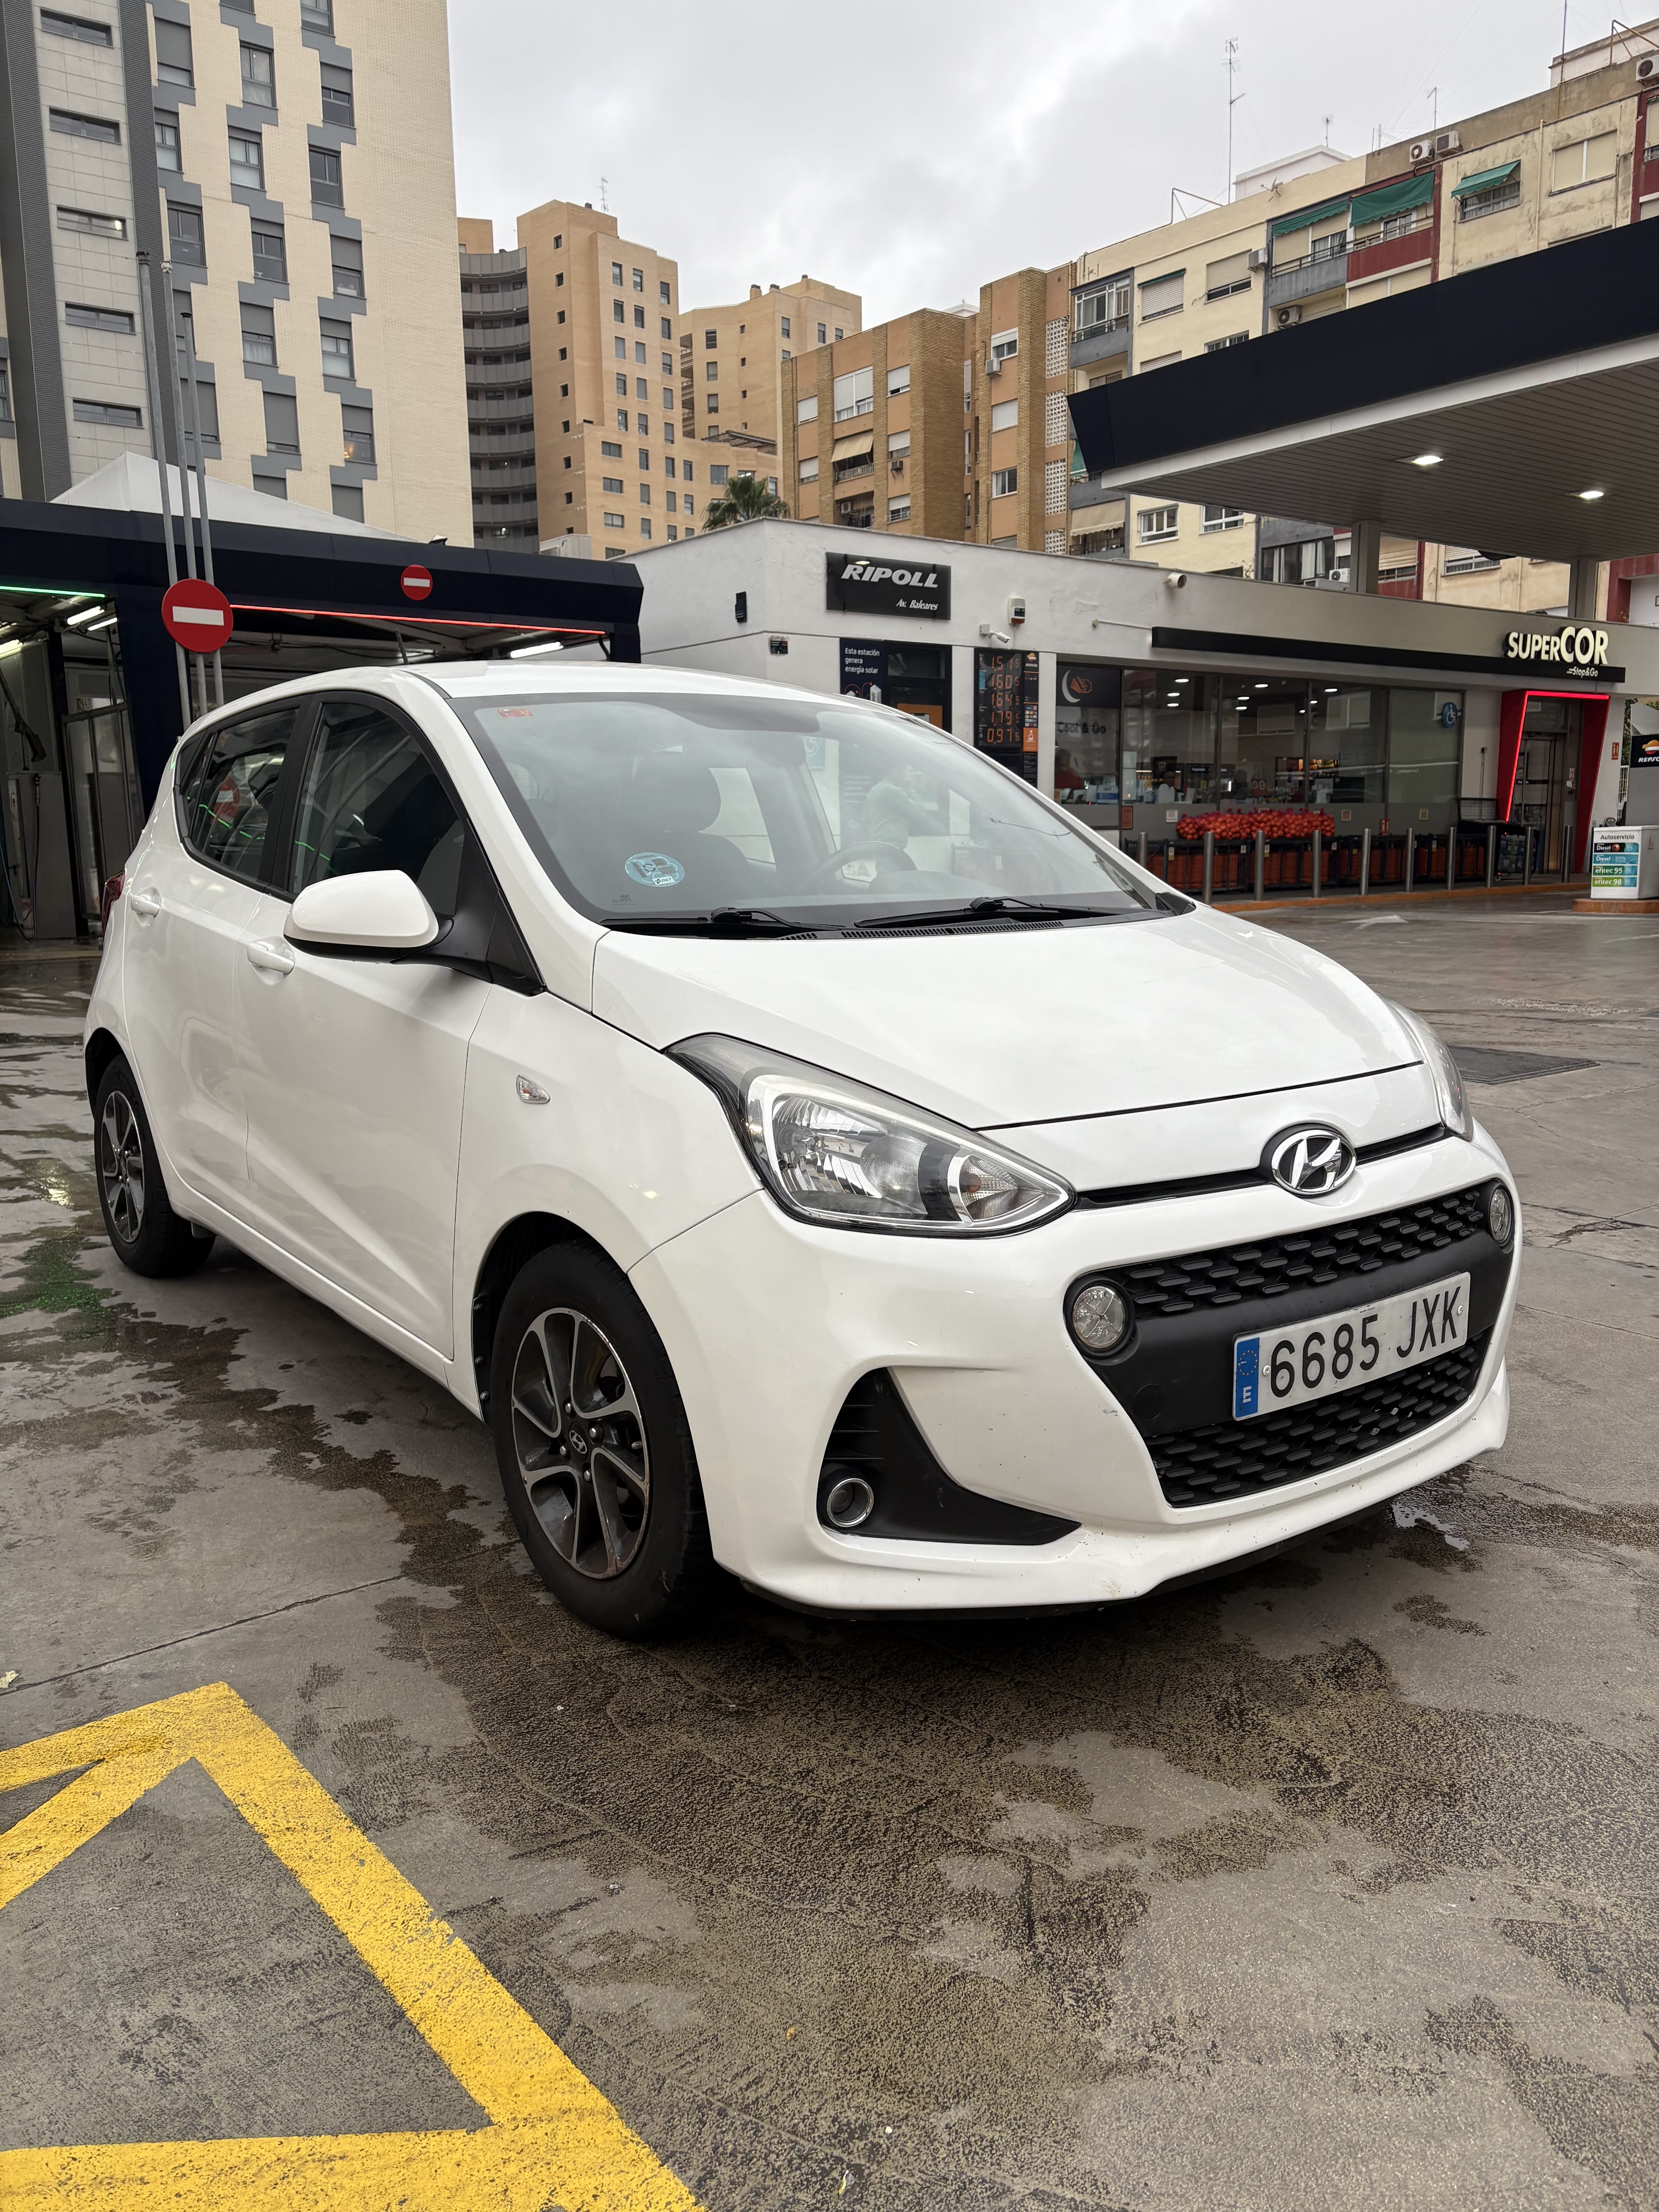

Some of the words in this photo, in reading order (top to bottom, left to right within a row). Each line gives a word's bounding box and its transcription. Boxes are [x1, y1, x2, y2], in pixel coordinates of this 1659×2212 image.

[841, 564, 938, 588] RIPOLL
[896, 598, 906, 608] Av.
[909, 599, 938, 610] Baleares
[1507, 626, 1608, 665] SUPERCOR
[1271, 1314, 1379, 1398] 6685
[1396, 1286, 1461, 1358] JXK
[1242, 1386, 1252, 1403] E
